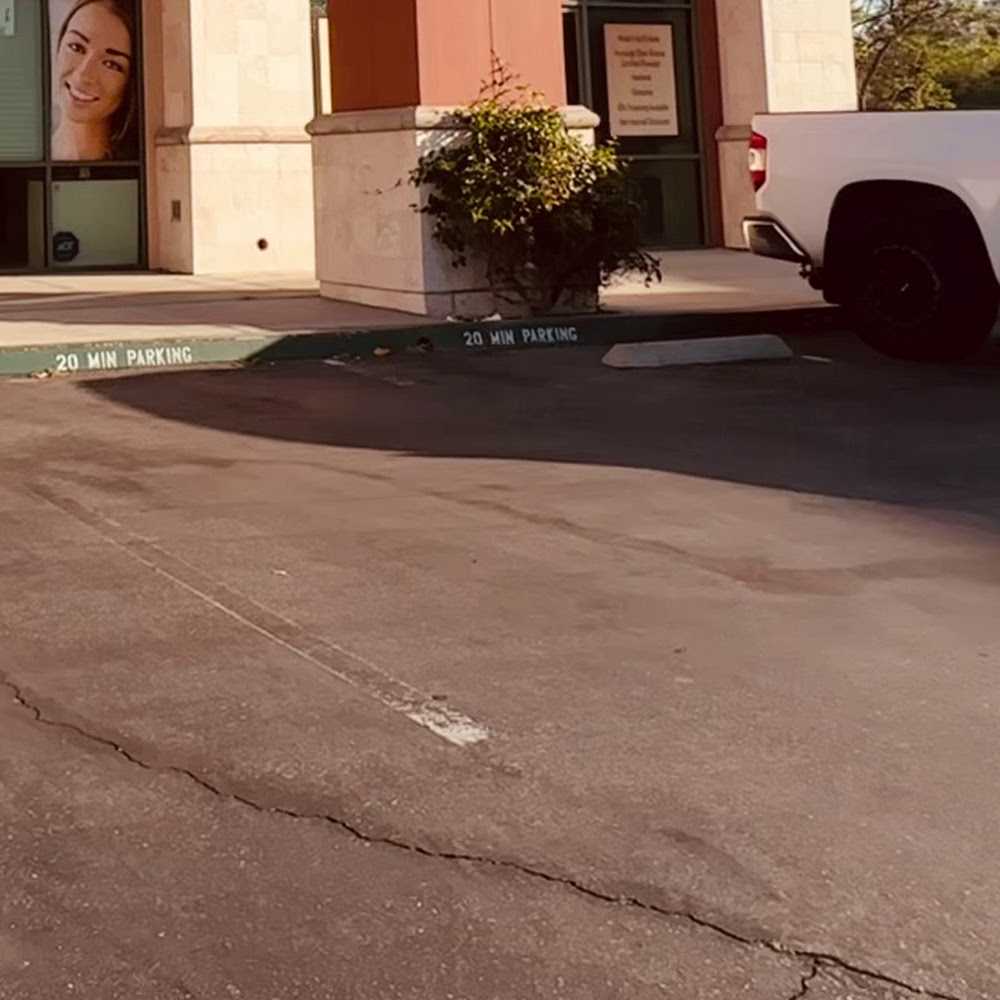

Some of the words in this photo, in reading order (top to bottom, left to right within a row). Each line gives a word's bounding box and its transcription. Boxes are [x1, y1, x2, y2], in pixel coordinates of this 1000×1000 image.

[463, 331, 483, 346] 20
[490, 329, 515, 345] MIN
[521, 327, 578, 343] PARKING
[56, 353, 79, 371] 20
[87, 350, 117, 368] MIN
[127, 346, 193, 365] PARKING
